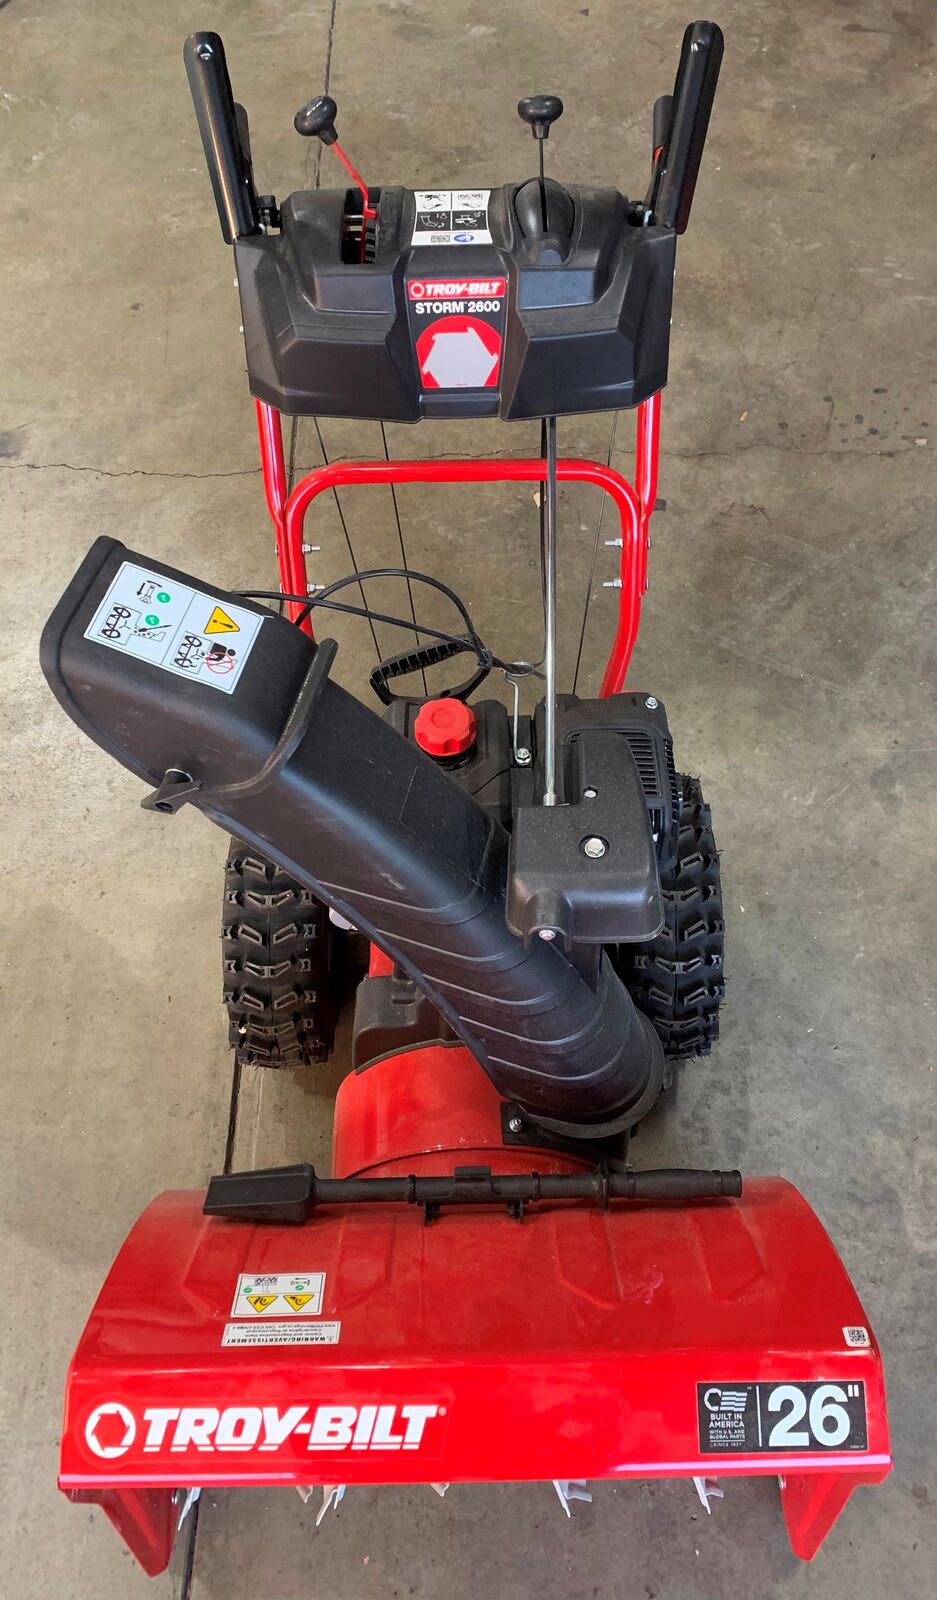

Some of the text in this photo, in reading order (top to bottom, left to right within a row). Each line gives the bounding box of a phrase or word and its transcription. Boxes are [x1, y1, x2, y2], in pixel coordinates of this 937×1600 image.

[425, 282, 502, 296] TROY-BILT
[467, 301, 500, 313] 2600
[768, 1384, 859, 1447] 26"
[709, 1420, 745, 1428] AMERICA
